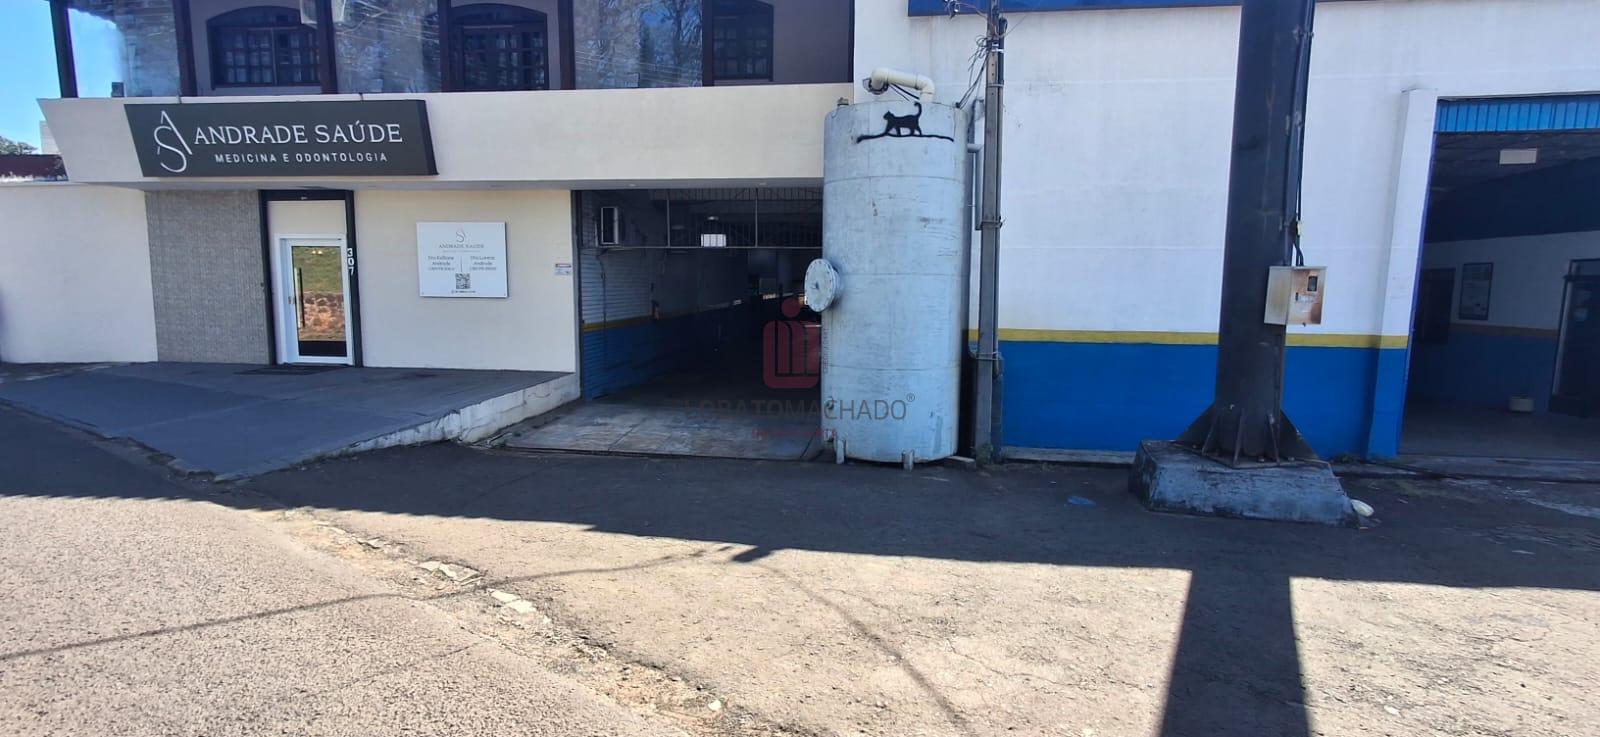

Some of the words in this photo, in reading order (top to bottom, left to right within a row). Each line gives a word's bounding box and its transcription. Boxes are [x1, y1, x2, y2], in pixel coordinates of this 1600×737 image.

[194, 125, 308, 145] ANDRADE
[314, 120, 403, 143] SAÚDE
[215, 153, 277, 163] MEDICINA
[283, 153, 290, 162] E
[295, 152, 388, 162] ODONTOLOGIA
[347, 247, 355, 276] 307
